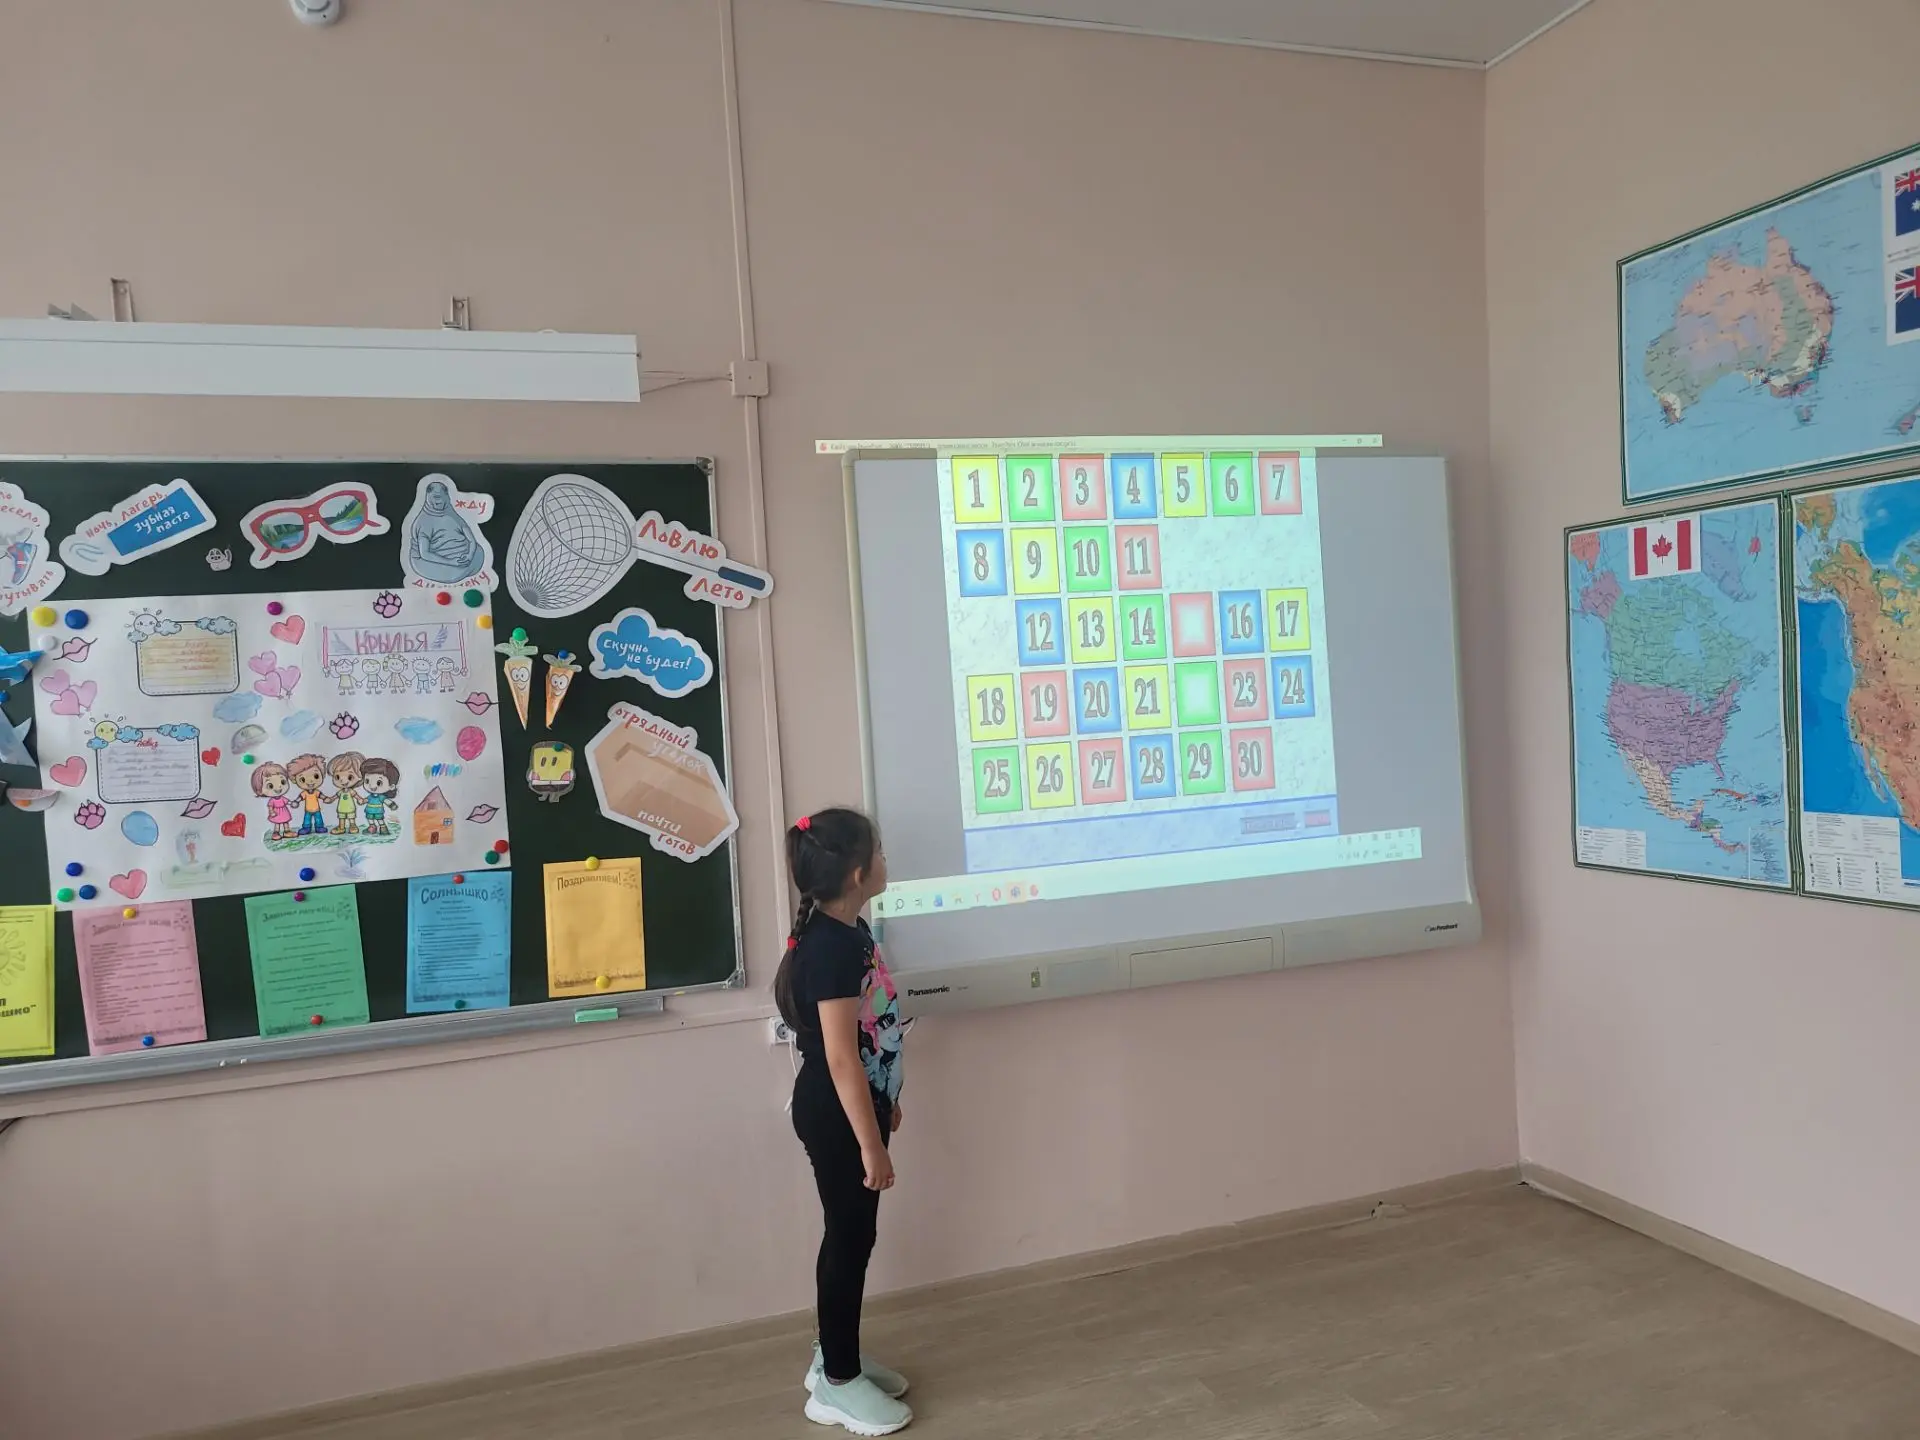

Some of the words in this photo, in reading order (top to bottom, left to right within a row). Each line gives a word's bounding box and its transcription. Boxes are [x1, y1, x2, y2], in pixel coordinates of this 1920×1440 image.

[968, 469, 985, 508] 1
[1022, 468, 1038, 506] 2
[1075, 467, 1089, 505] 3
[1126, 466, 1141, 504] 4
[1176, 466, 1190, 503] 5
[1225, 465, 1239, 501] 6
[1272, 464, 1285, 500] 7
[134, 506, 176, 535] зубная
[156, 511, 190, 533] паста
[973, 542, 989, 581] 8
[1027, 541, 1041, 579] 9
[1073, 538, 1100, 576] 10
[1124, 537, 1152, 575] 11
[0, 570, 54, 607] утывать
[692, 578, 744, 601] Лето
[1026, 612, 1054, 651] 12
[1078, 609, 1105, 648] 13
[1129, 607, 1156, 645] 14
[1228, 603, 1253, 640] 16
[1275, 600, 1299, 637] 17
[603, 639, 649, 656] Скучно
[627, 653, 641, 663] не
[977, 687, 1006, 726] 18
[1030, 683, 1058, 722] 19
[1083, 680, 1110, 718] 20
[1134, 677, 1161, 715] 21
[1233, 671, 1258, 708] 23
[1280, 668, 1306, 704] 24
[615, 707, 691, 748] отрядный
[983, 759, 1011, 798] 25
[1036, 754, 1064, 793] 26
[1091, 751, 1116, 789] 27
[1139, 746, 1165, 784] 28
[1187, 742, 1212, 780] 29
[1238, 741, 1262, 778] 30
[638, 810, 682, 834] почти
[658, 833, 696, 855] готов
[421, 887, 489, 905] Солнышко
[907, 985, 950, 996] Panasonic
